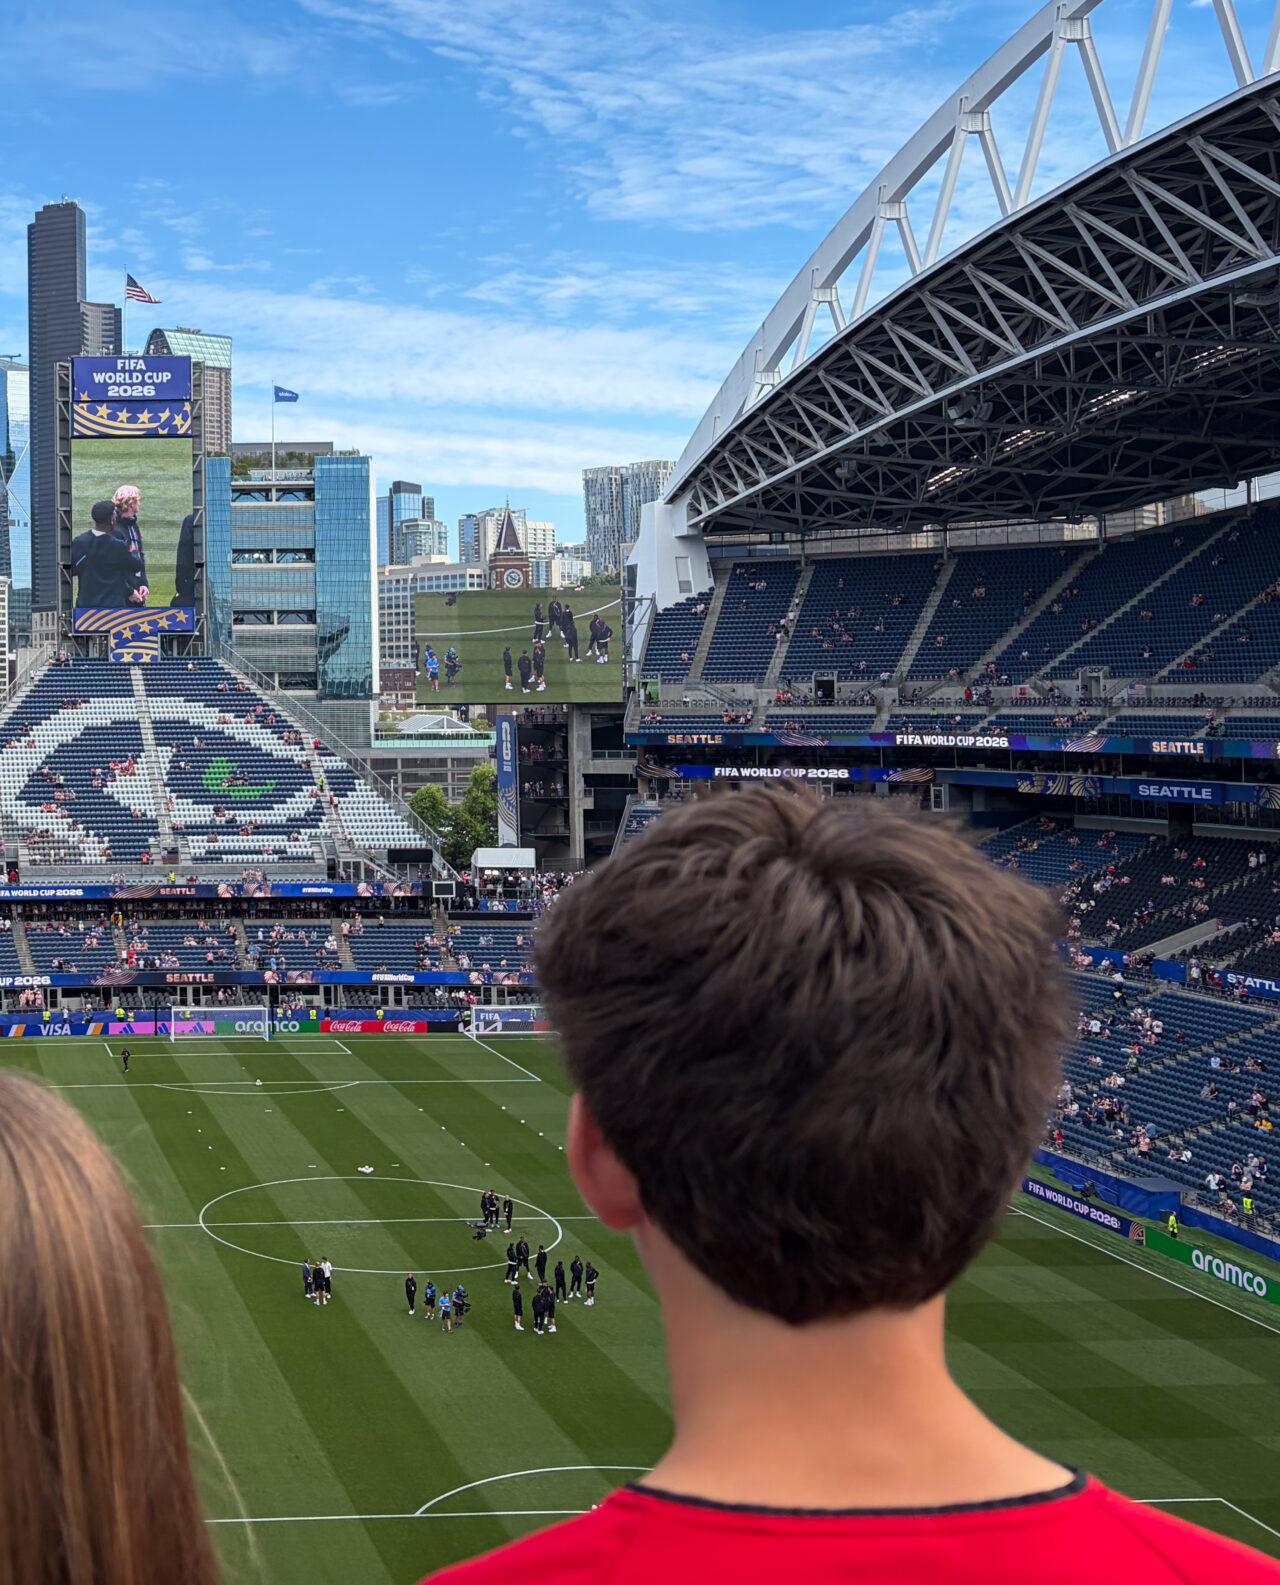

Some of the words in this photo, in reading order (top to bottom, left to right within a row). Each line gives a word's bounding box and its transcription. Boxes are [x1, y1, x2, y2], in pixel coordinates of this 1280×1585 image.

[117, 359, 146, 370] FIFA
[93, 372, 142, 383] WORLD
[144, 372, 171, 383] CUP
[107, 385, 156, 397] 2026
[667, 734, 722, 744] SEATTLE
[896, 735, 922, 745] FIFA
[923, 735, 955, 746] WORLD
[957, 736, 975, 746] CUP
[975, 737, 1008, 747] 2026
[1152, 741, 1204, 754] SEATTLE
[714, 768, 738, 777] FIFA
[740, 768, 781, 777] WORLD
[783, 769, 806, 778] CUP
[807, 769, 849, 778] 2026
[1139, 785, 1212, 799] SEATTLE
[10, 889, 39, 897] WORLD
[56, 888, 84, 896] 2026
[14, 976, 51, 986] 2026
[166, 973, 214, 983] SEATTLE
[372, 973, 415, 983] #FIFAWorldCup
[37, 1023, 71, 1036] VISA
[235, 1020, 300, 1033] aramco
[1028, 1181, 1045, 1197] FIFA
[1045, 1189, 1073, 1209] WORLD
[1073, 1201, 1089, 1216] CUP
[1090, 1208, 1118, 1229] 2026
[1192, 1249, 1267, 1296] aramco
